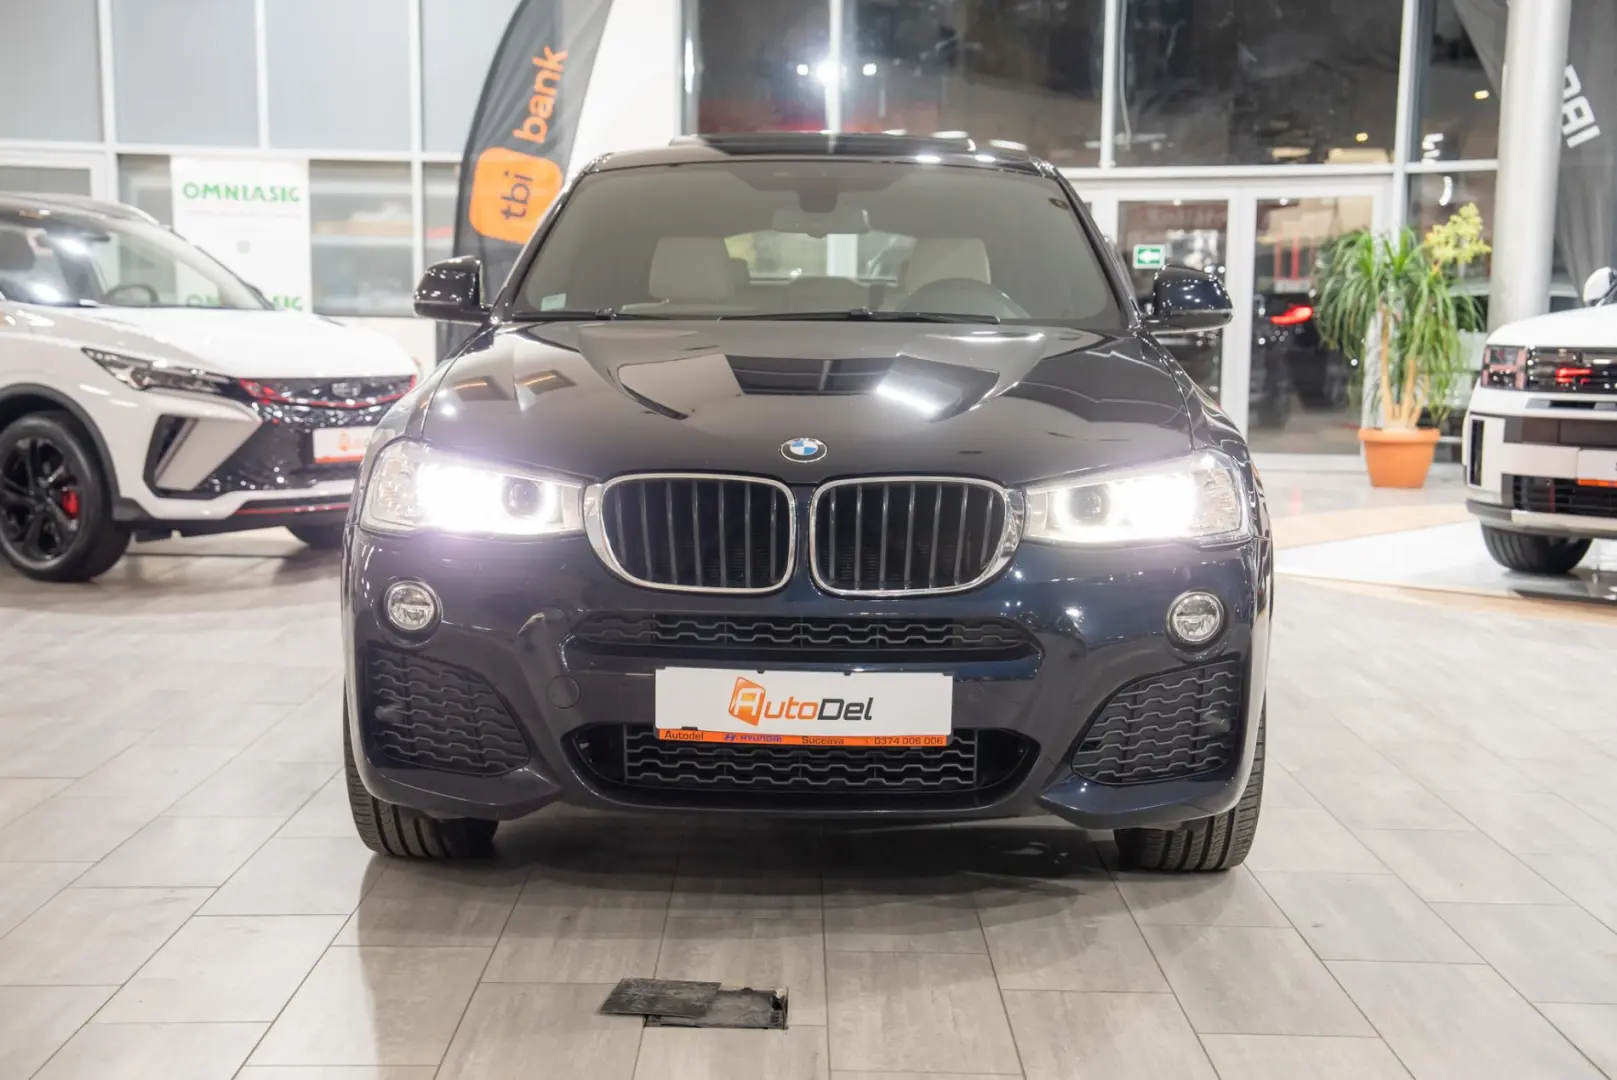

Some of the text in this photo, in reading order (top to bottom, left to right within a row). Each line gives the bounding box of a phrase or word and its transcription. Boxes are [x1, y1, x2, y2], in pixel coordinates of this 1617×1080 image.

[501, 45, 569, 220] tbi bank
[729, 681, 874, 722] AutoDel
[664, 730, 704, 741] Autodel
[801, 736, 845, 745] Suceava
[874, 737, 900, 745] 0374
